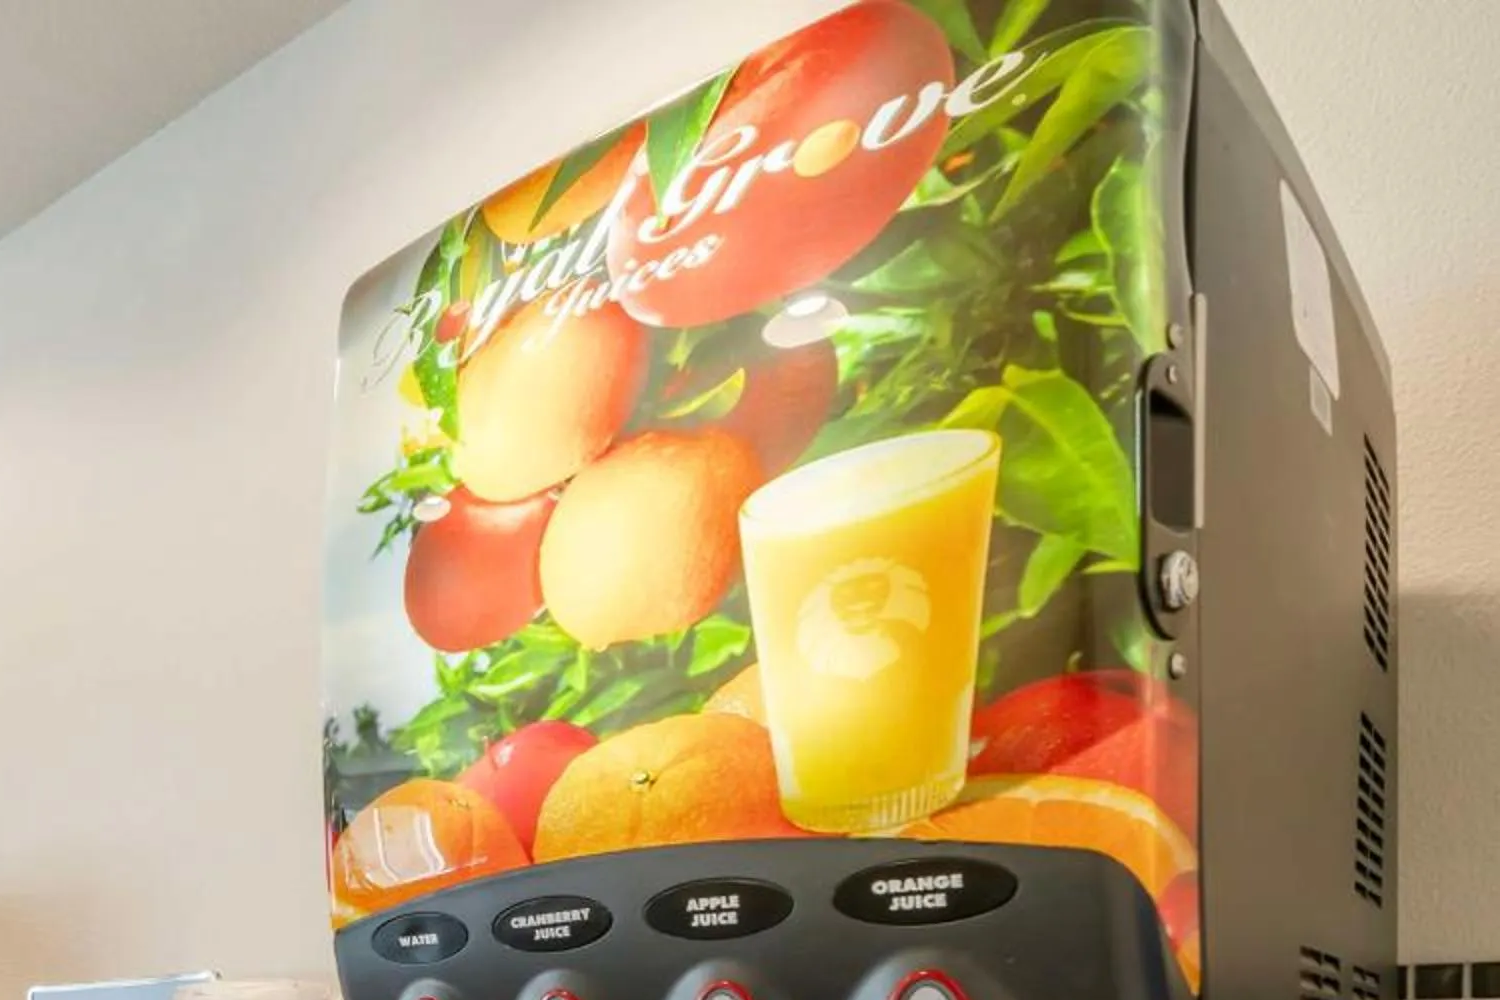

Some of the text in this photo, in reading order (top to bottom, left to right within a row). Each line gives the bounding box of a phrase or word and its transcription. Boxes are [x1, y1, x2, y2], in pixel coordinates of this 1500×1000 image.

[520, 233, 724, 352] Juices
[871, 873, 964, 895] ORANGE
[686, 895, 740, 912] APPLE
[888, 893, 947, 911] JUICE
[510, 907, 591, 928] CRANBERRY
[690, 911, 739, 927] JUICE
[398, 933, 439, 948] WATER
[533, 926, 571, 941] JUICE
